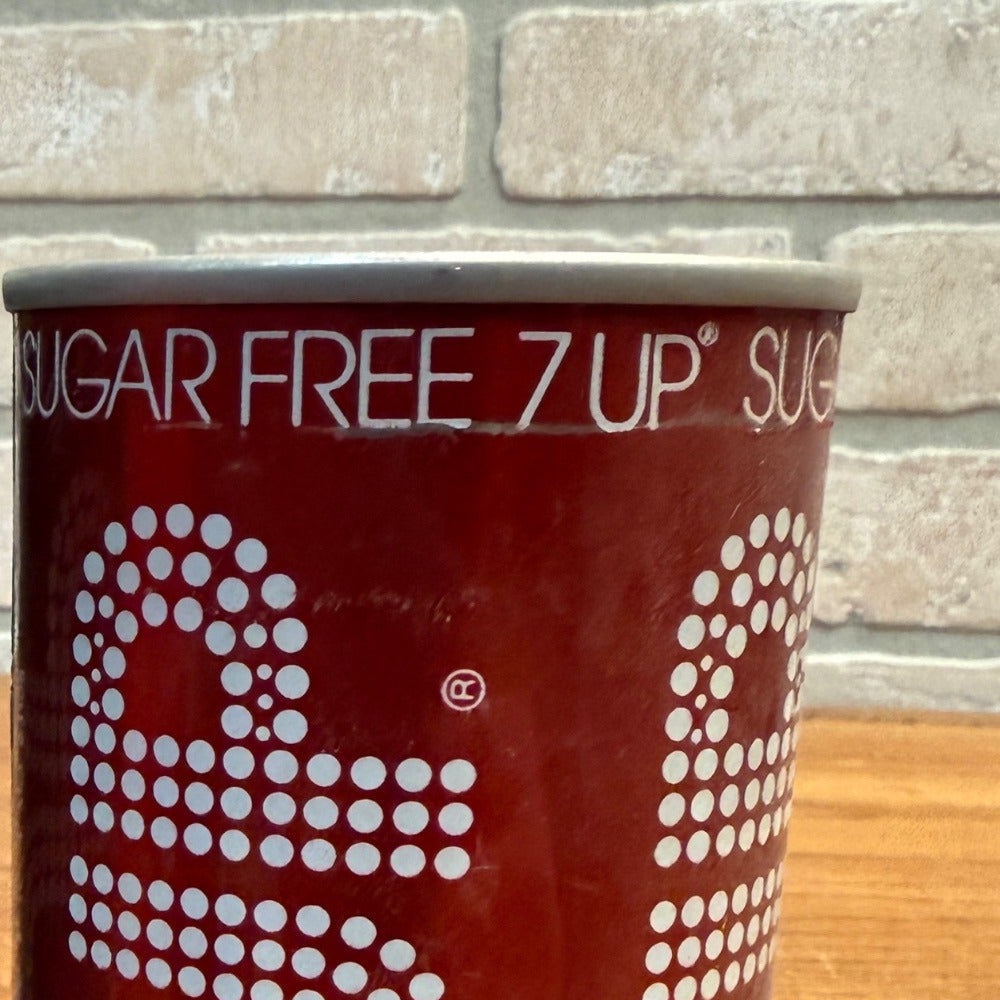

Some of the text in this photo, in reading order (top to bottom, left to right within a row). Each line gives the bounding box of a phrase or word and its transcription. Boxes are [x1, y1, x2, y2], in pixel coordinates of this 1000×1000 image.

[22, 327, 218, 425] SUGAR
[240, 327, 475, 430] FREE
[518, 331, 573, 431] 7
